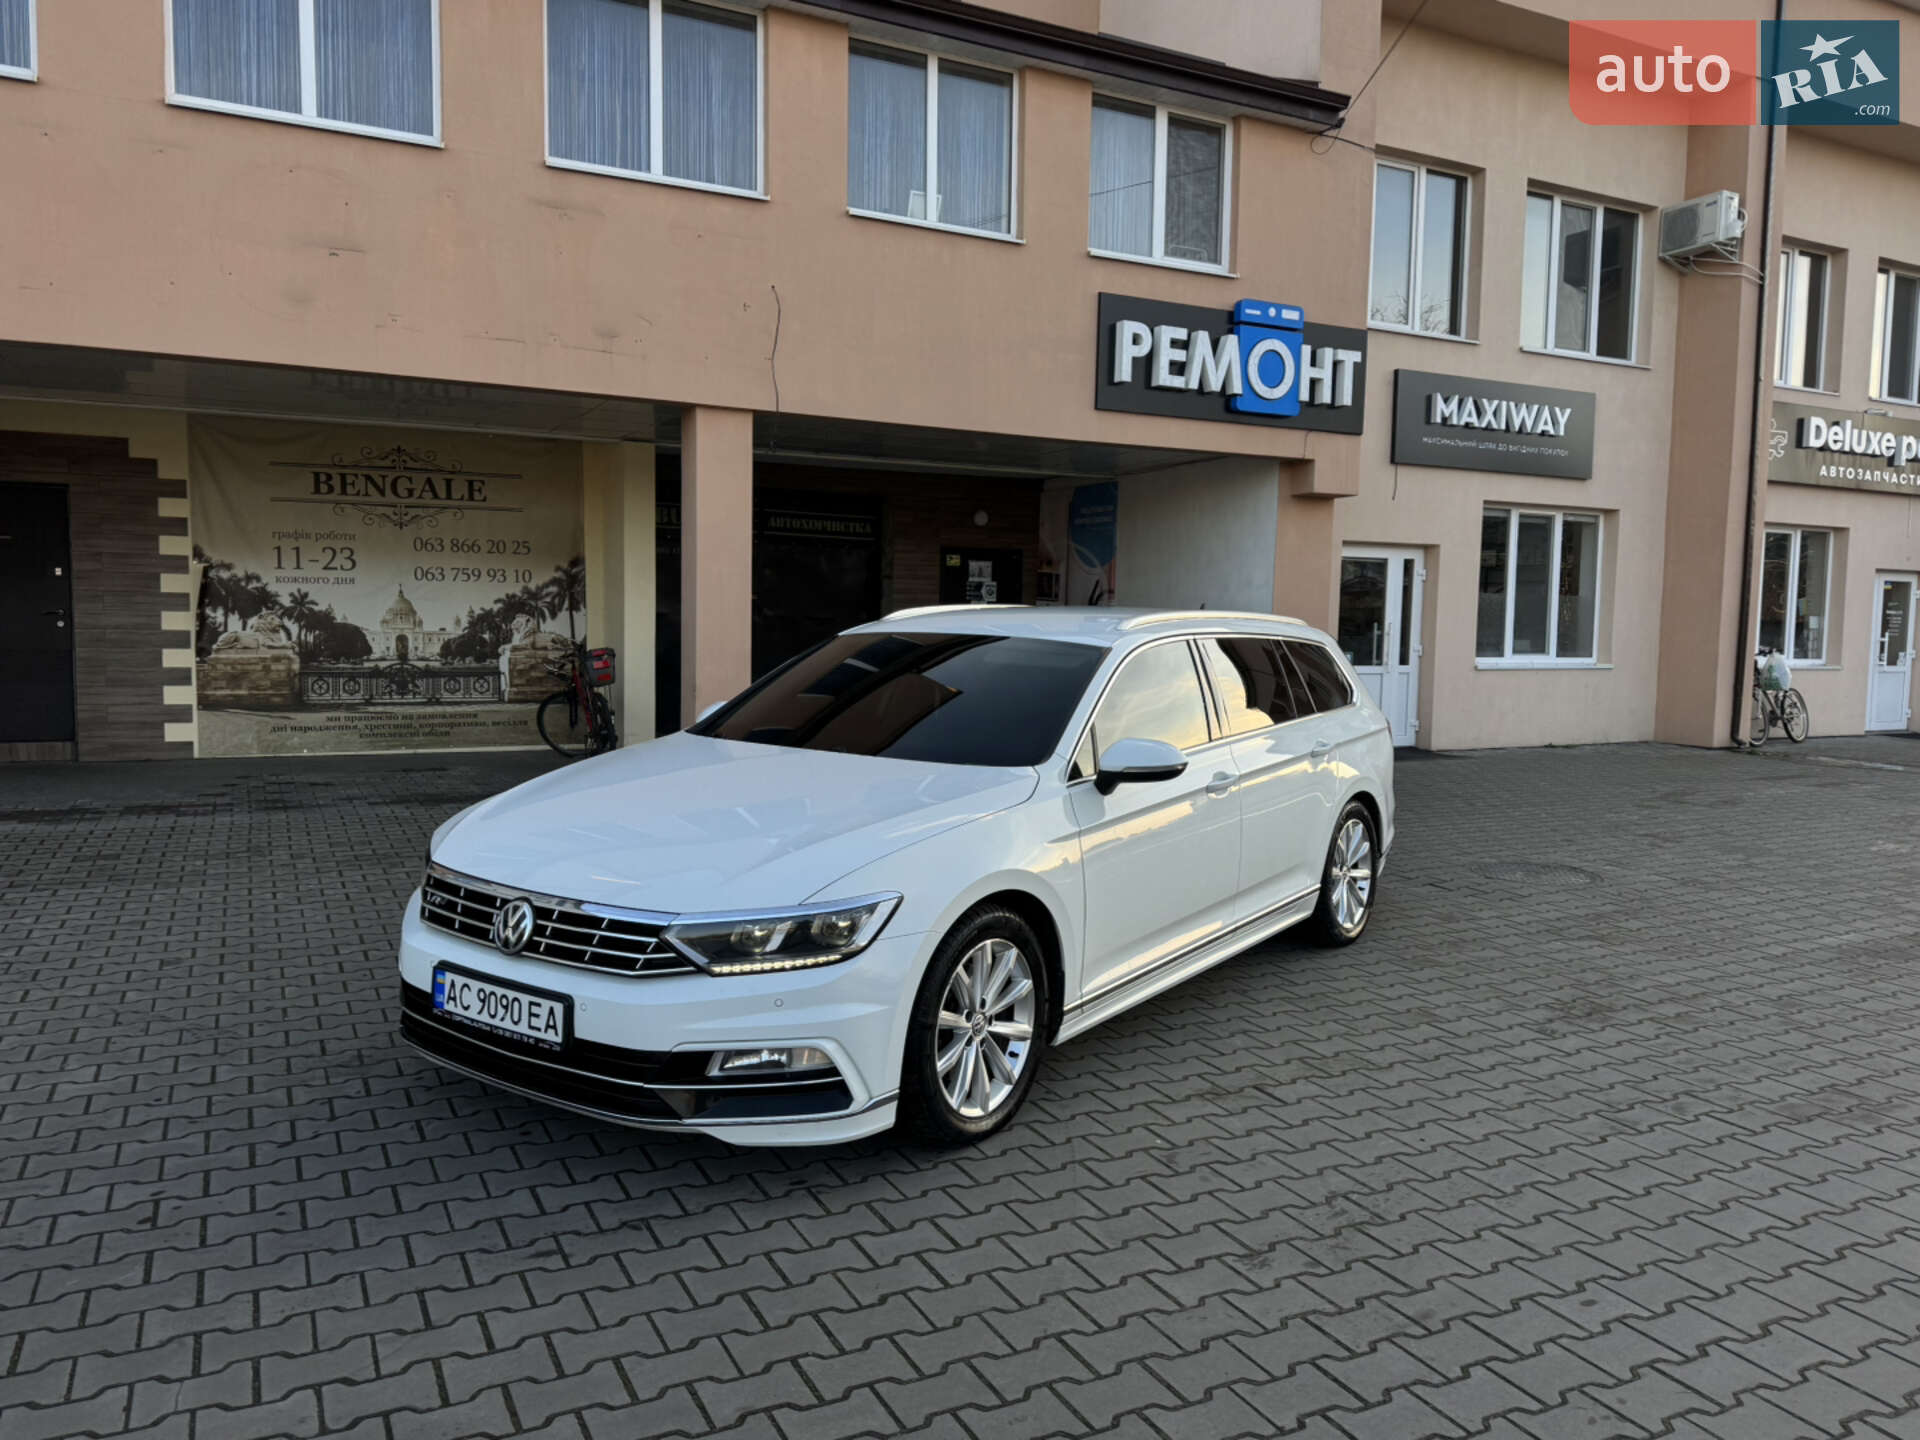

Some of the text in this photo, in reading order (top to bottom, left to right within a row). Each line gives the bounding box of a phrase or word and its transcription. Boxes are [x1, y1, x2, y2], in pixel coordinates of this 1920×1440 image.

[1114, 319, 1362, 407] РЕМОНТ
[1430, 392, 1572, 436] MAXIWAY
[1497, 443, 1508, 452] ДО
[1803, 415, 1897, 457] Deluxe
[310, 470, 488, 503] BENGALE
[271, 528, 357, 543] графік роботи
[413, 536, 532, 556] 063 866 20 25
[272, 544, 358, 572] 11-23
[275, 574, 356, 587] кожного дня
[413, 566, 533, 585] 063 759 93 10
[446, 978, 472, 1011] AC
[476, 987, 523, 1026] 9090
[527, 1000, 559, 1037] EA
